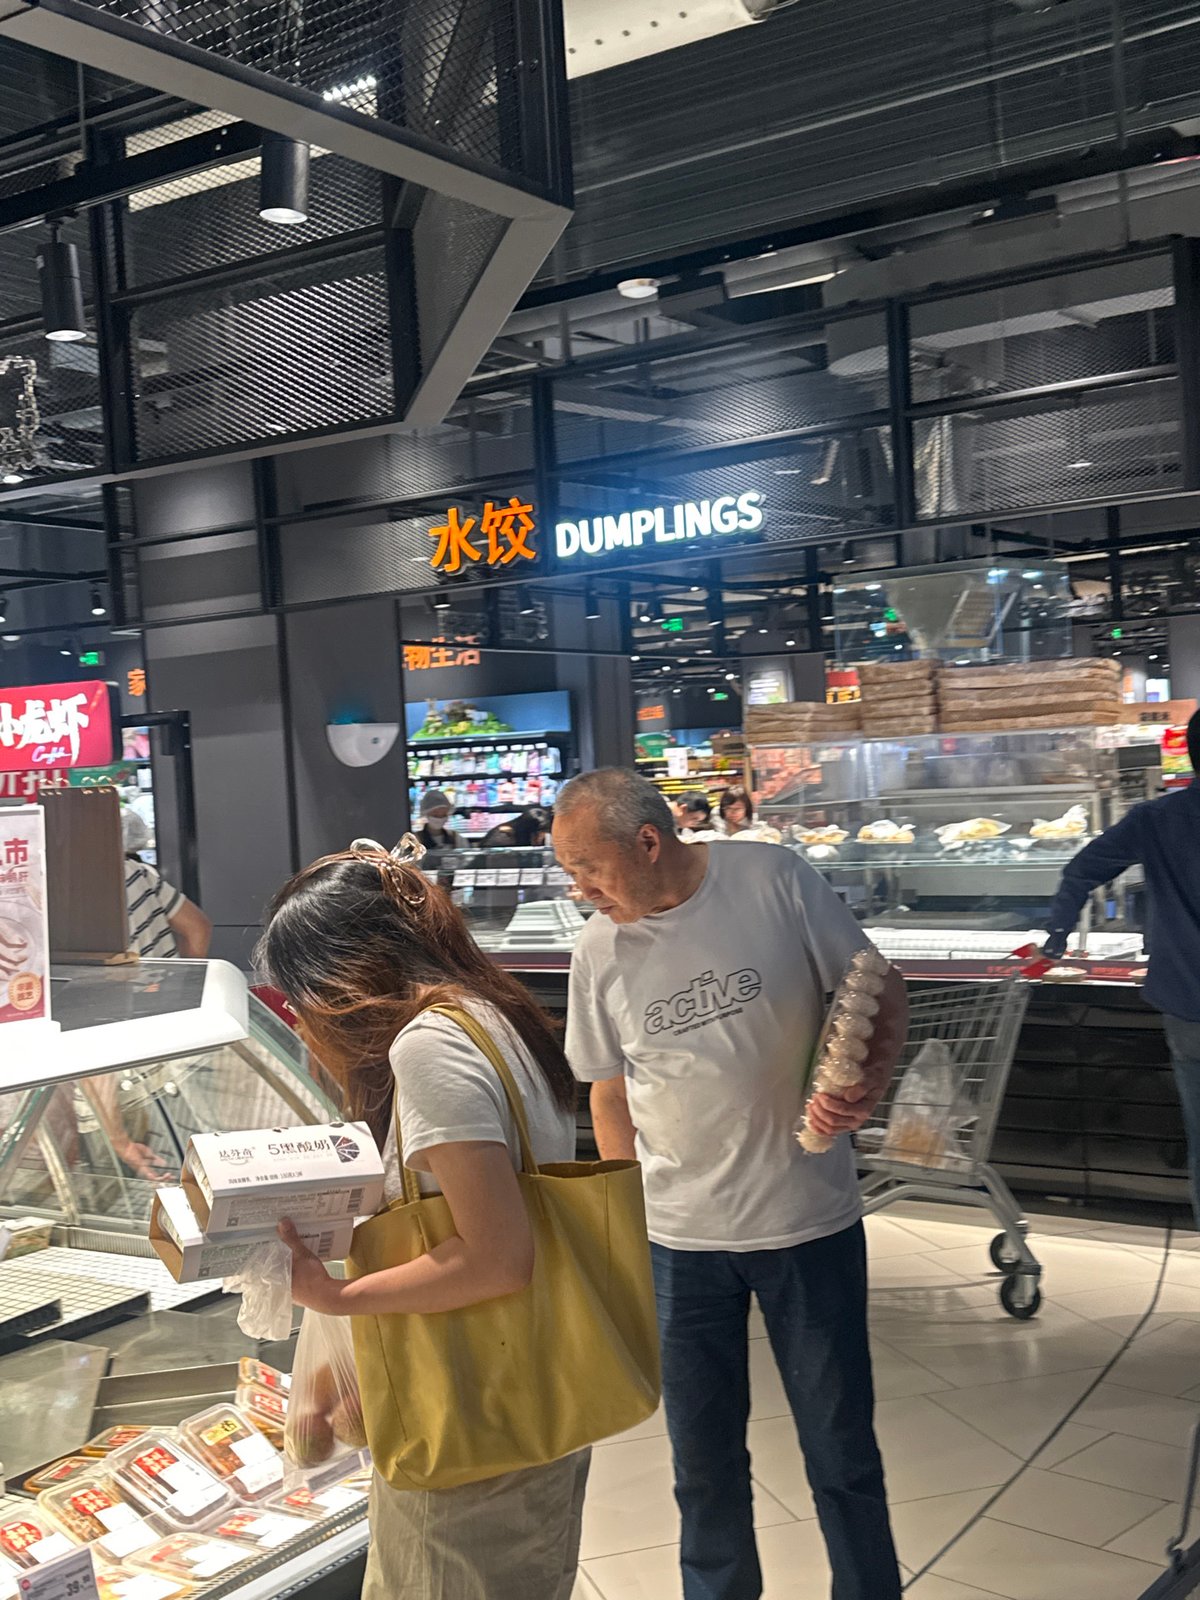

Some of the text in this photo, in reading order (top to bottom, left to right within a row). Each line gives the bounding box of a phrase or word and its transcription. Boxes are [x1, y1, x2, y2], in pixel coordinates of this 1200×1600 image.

[428, 496, 537, 573] 水饺
[554, 491, 764, 559] DUMPLINGS
[644, 967, 762, 1035] active
[267, 1139, 331, 1156] 5黑酸奶
